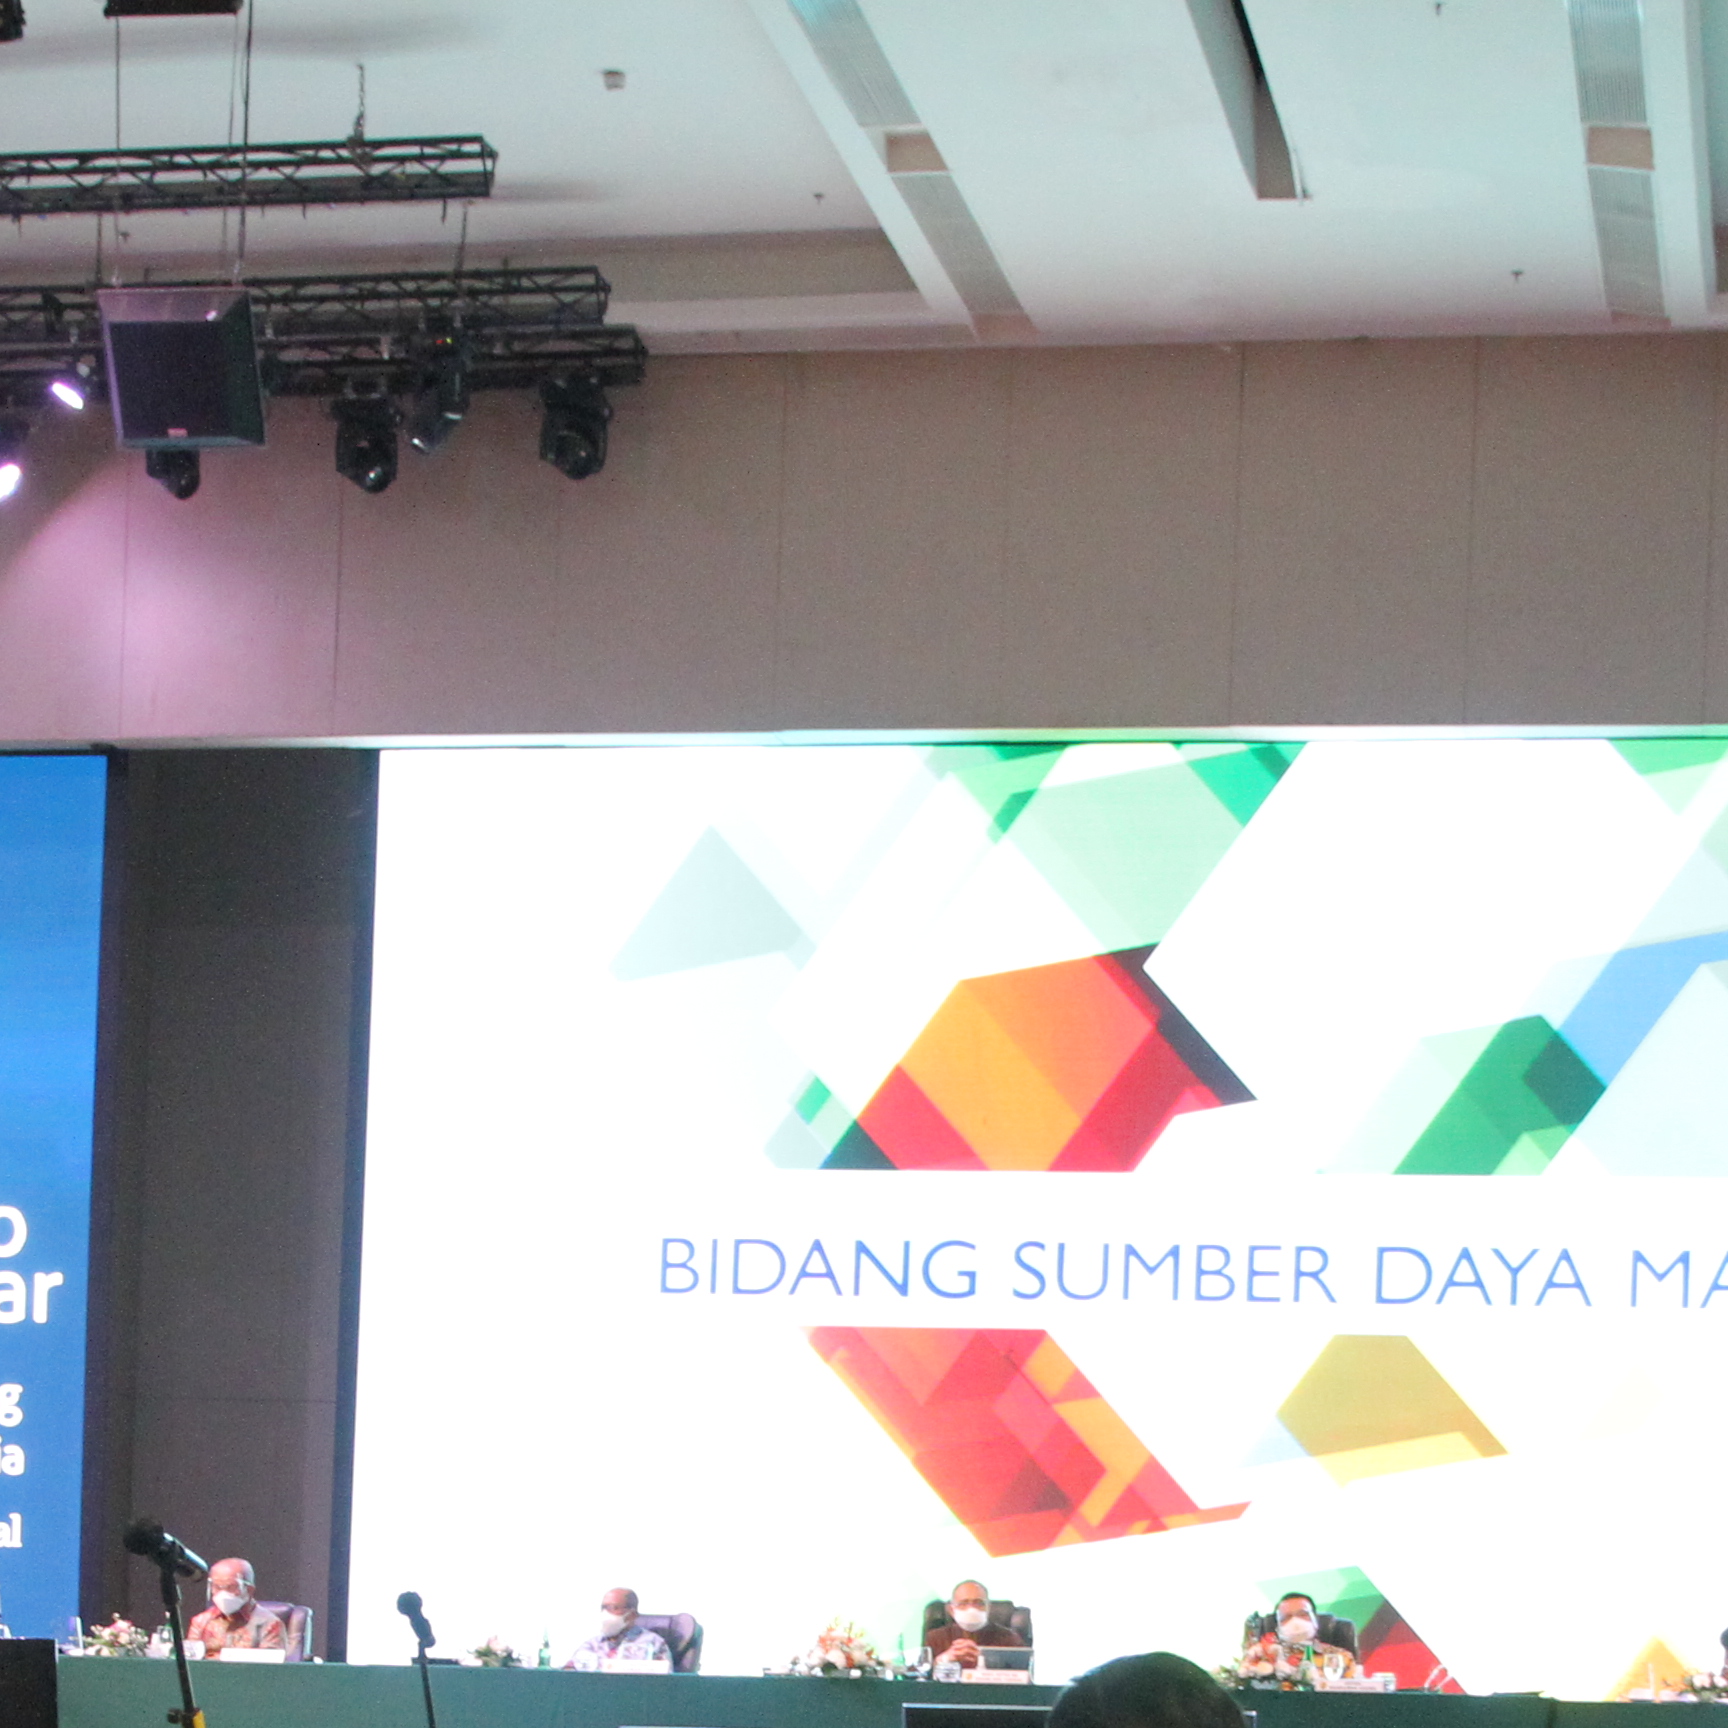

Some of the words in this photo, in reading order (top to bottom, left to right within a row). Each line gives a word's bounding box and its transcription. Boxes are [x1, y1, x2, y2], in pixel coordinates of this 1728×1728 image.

[660, 1237, 978, 1299] BIDANG
[1012, 1240, 1338, 1304] SUMBER
[1374, 1246, 1593, 1308] DAYA
